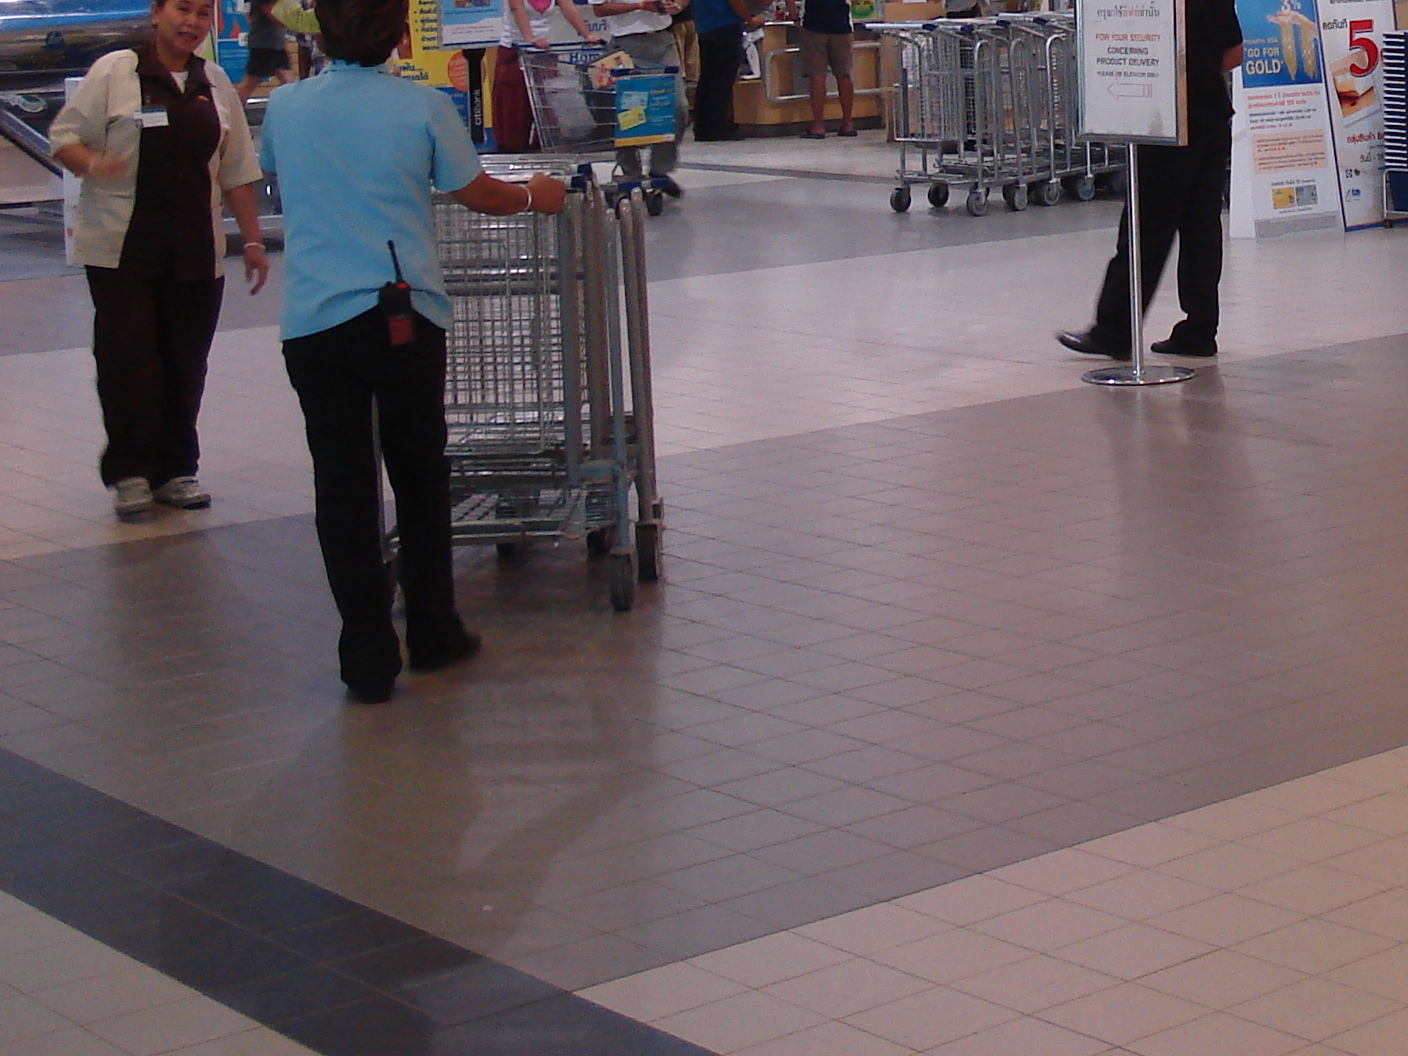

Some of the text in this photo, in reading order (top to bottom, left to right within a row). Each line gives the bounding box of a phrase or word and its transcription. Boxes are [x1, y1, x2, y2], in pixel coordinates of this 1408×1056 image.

[1130, 33, 1160, 42] SECURITY
[1263, 46, 1280, 56] FOR
[1349, 19, 1379, 78] 5
[1097, 57, 1160, 66] PRODUCT DELIVERY
